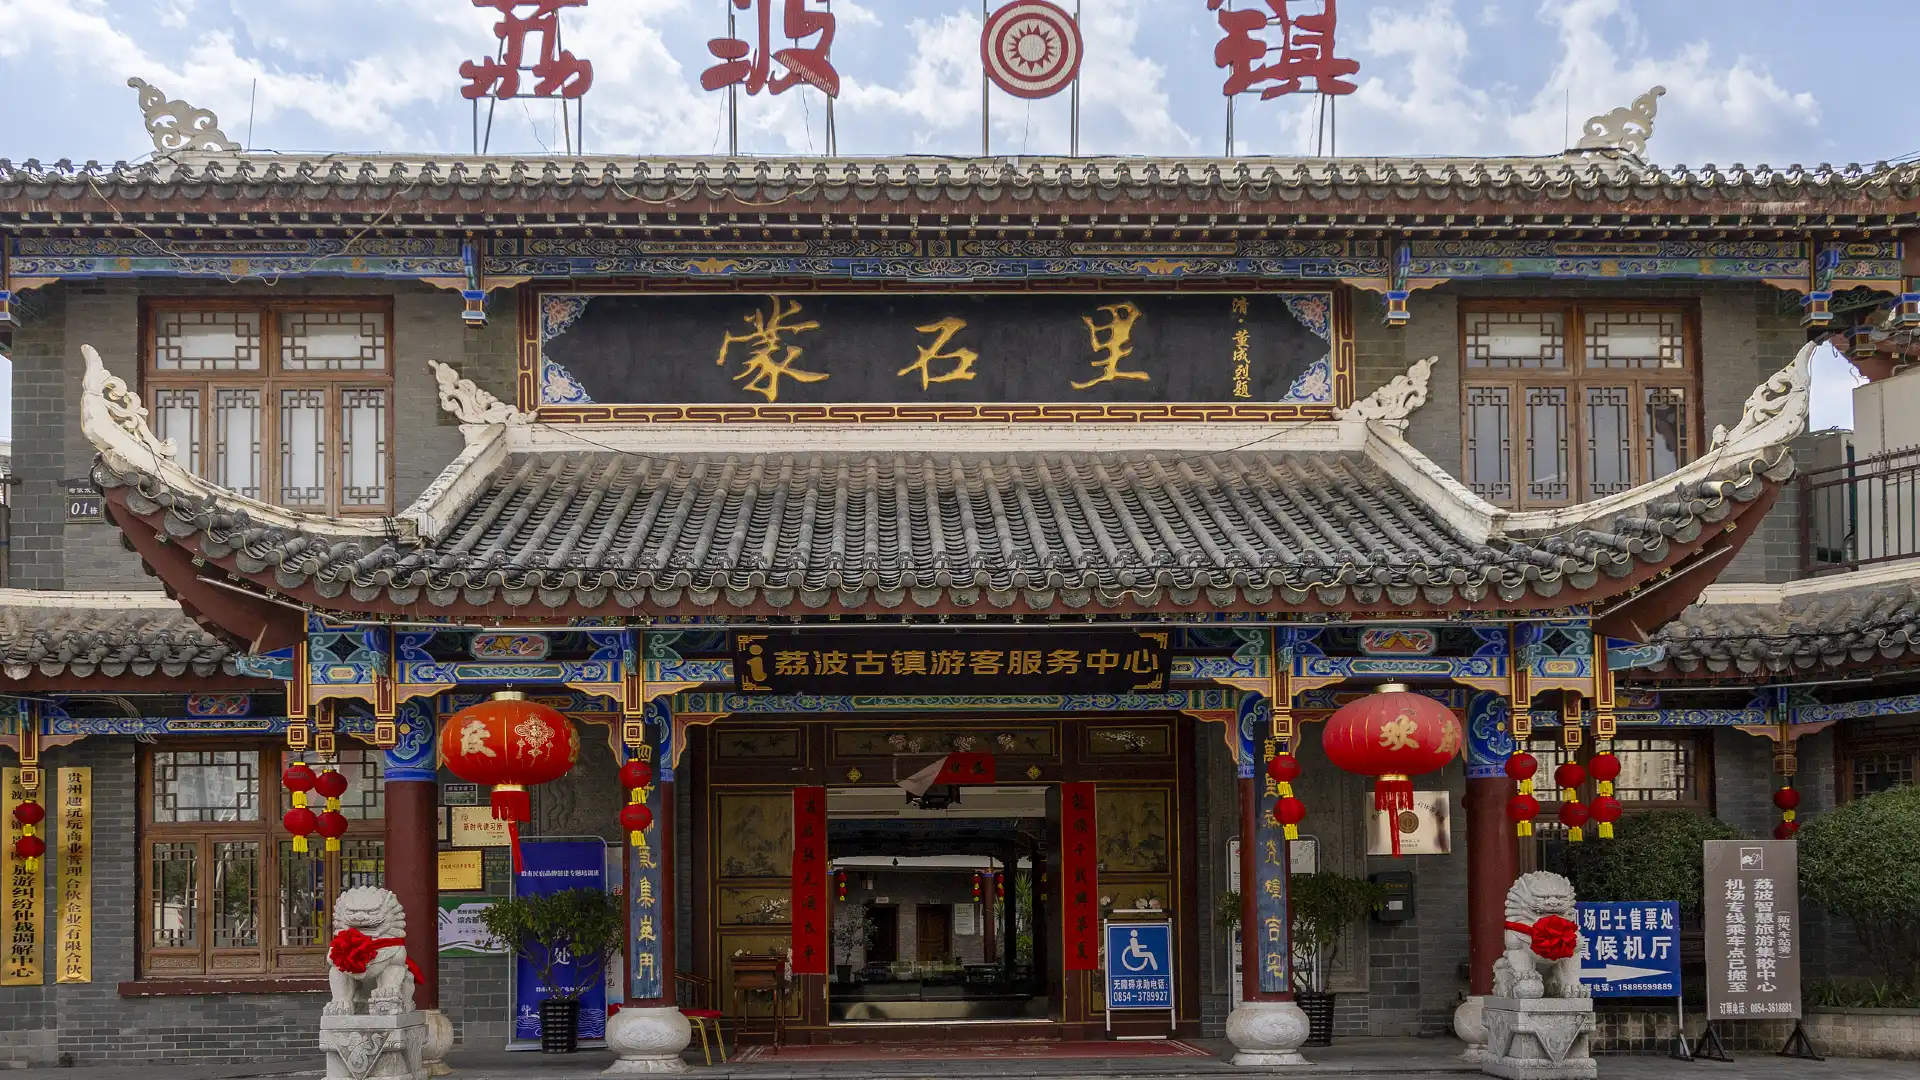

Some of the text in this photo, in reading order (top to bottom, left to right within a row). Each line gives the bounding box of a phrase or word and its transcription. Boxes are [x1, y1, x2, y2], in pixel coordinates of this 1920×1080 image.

[716, 295, 1151, 403] 蒙石里
[71, 502, 99, 515] 01栋
[774, 649, 1159, 676] 荔波古镇游客服务中心
[1724, 878, 1749, 993] 机场专线乘车点已搬至
[1753, 878, 1777, 992] 荔波智慧旅游集散中心
[1113, 979, 1169, 990] 无障碍求助电话:
[1113, 991, 1168, 1002] 0854-3789927
